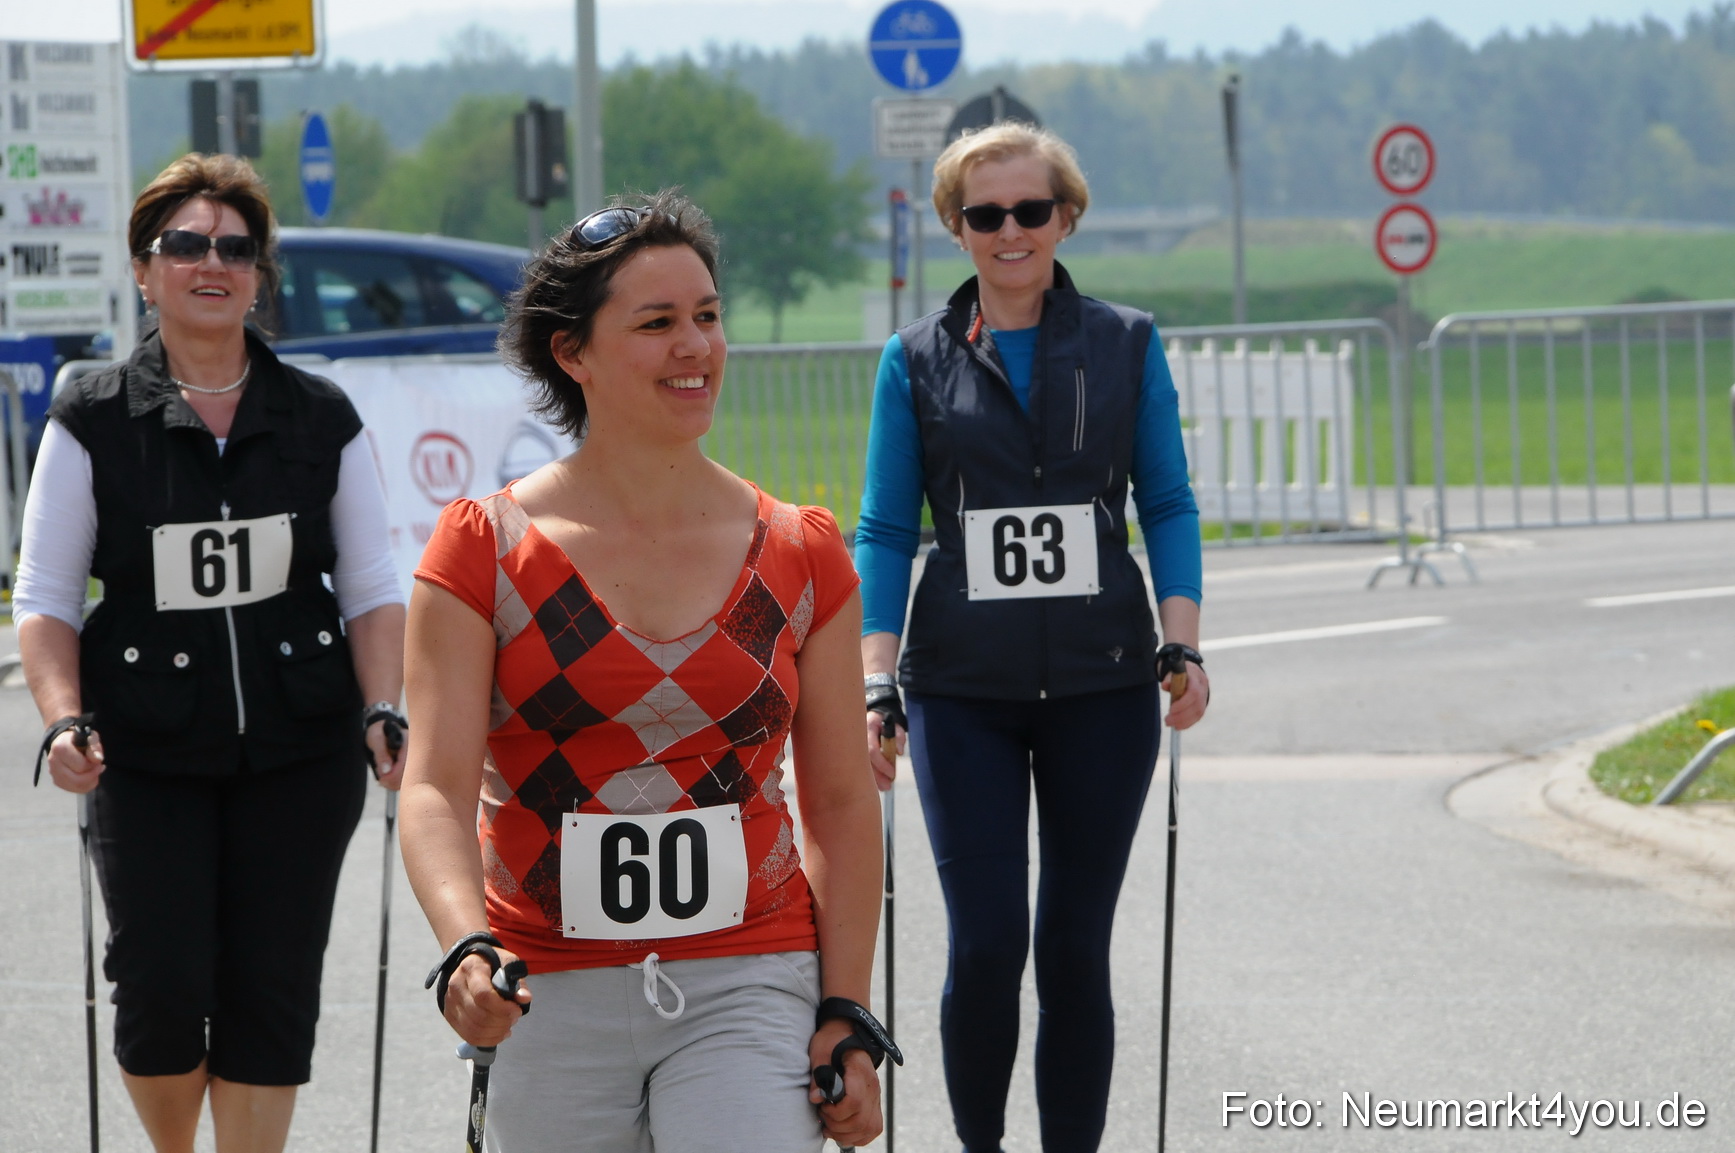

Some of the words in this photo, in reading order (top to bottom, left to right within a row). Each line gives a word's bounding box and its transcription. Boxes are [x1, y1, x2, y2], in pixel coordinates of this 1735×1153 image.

[190, 526, 252, 598] 61
[993, 512, 1066, 587] 63
[600, 817, 710, 924] 60
